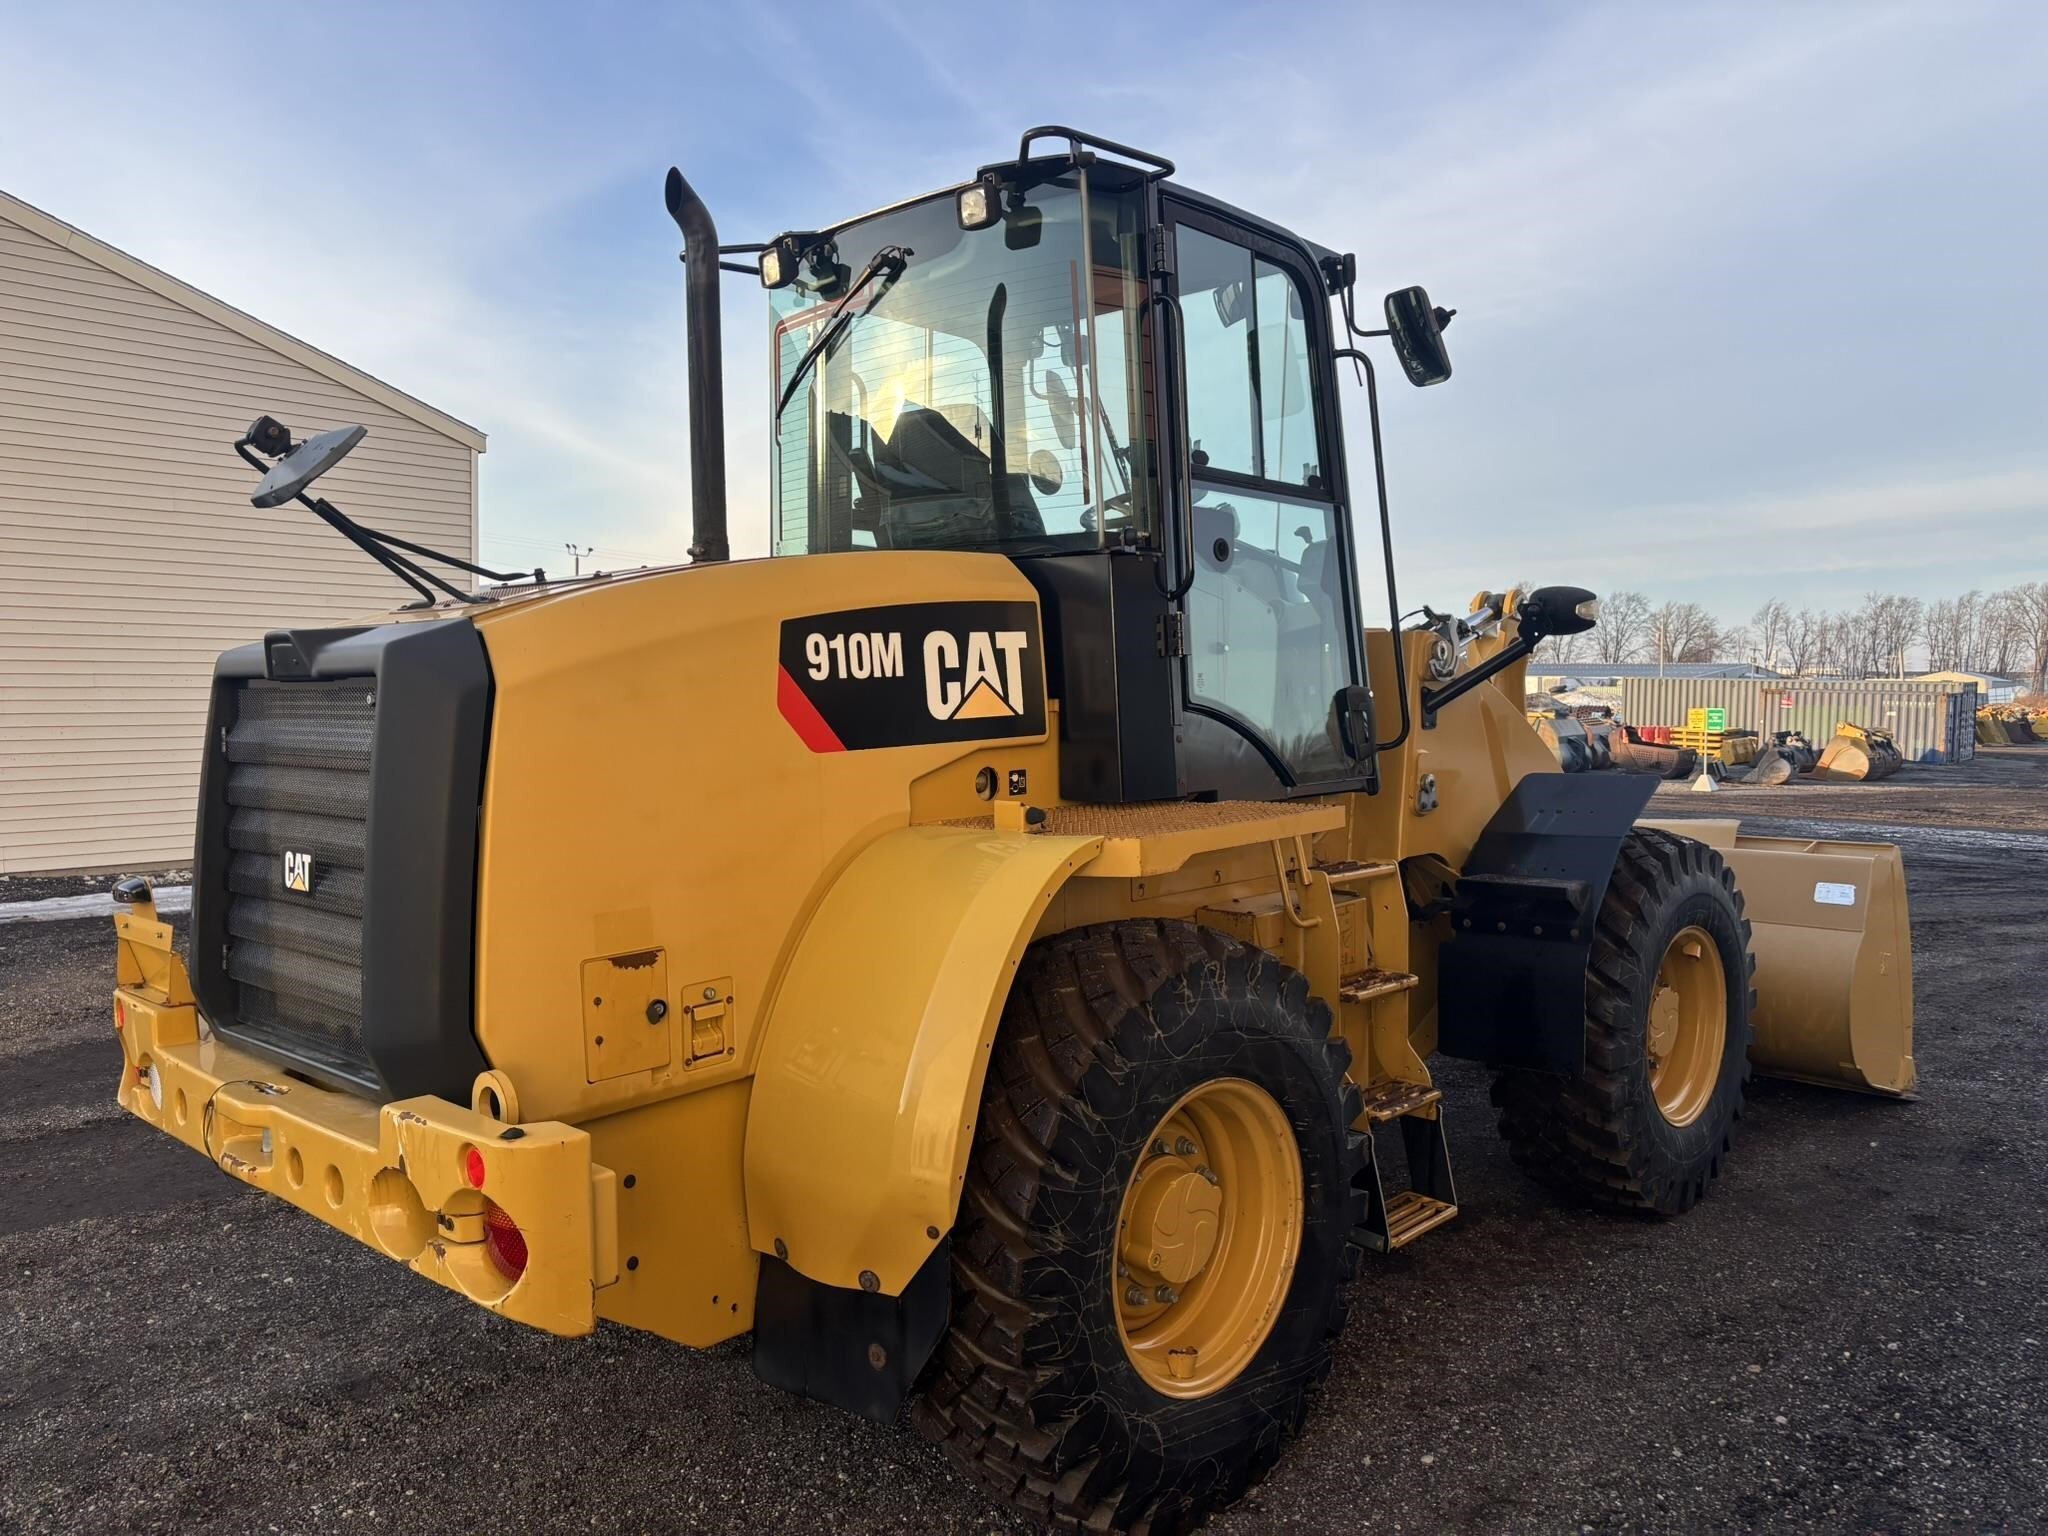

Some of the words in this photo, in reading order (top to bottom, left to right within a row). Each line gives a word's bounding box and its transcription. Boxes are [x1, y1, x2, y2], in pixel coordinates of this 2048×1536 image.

[806, 632, 904, 681] 910M
[923, 630, 1027, 720] CAT
[285, 851, 311, 892] CAT
